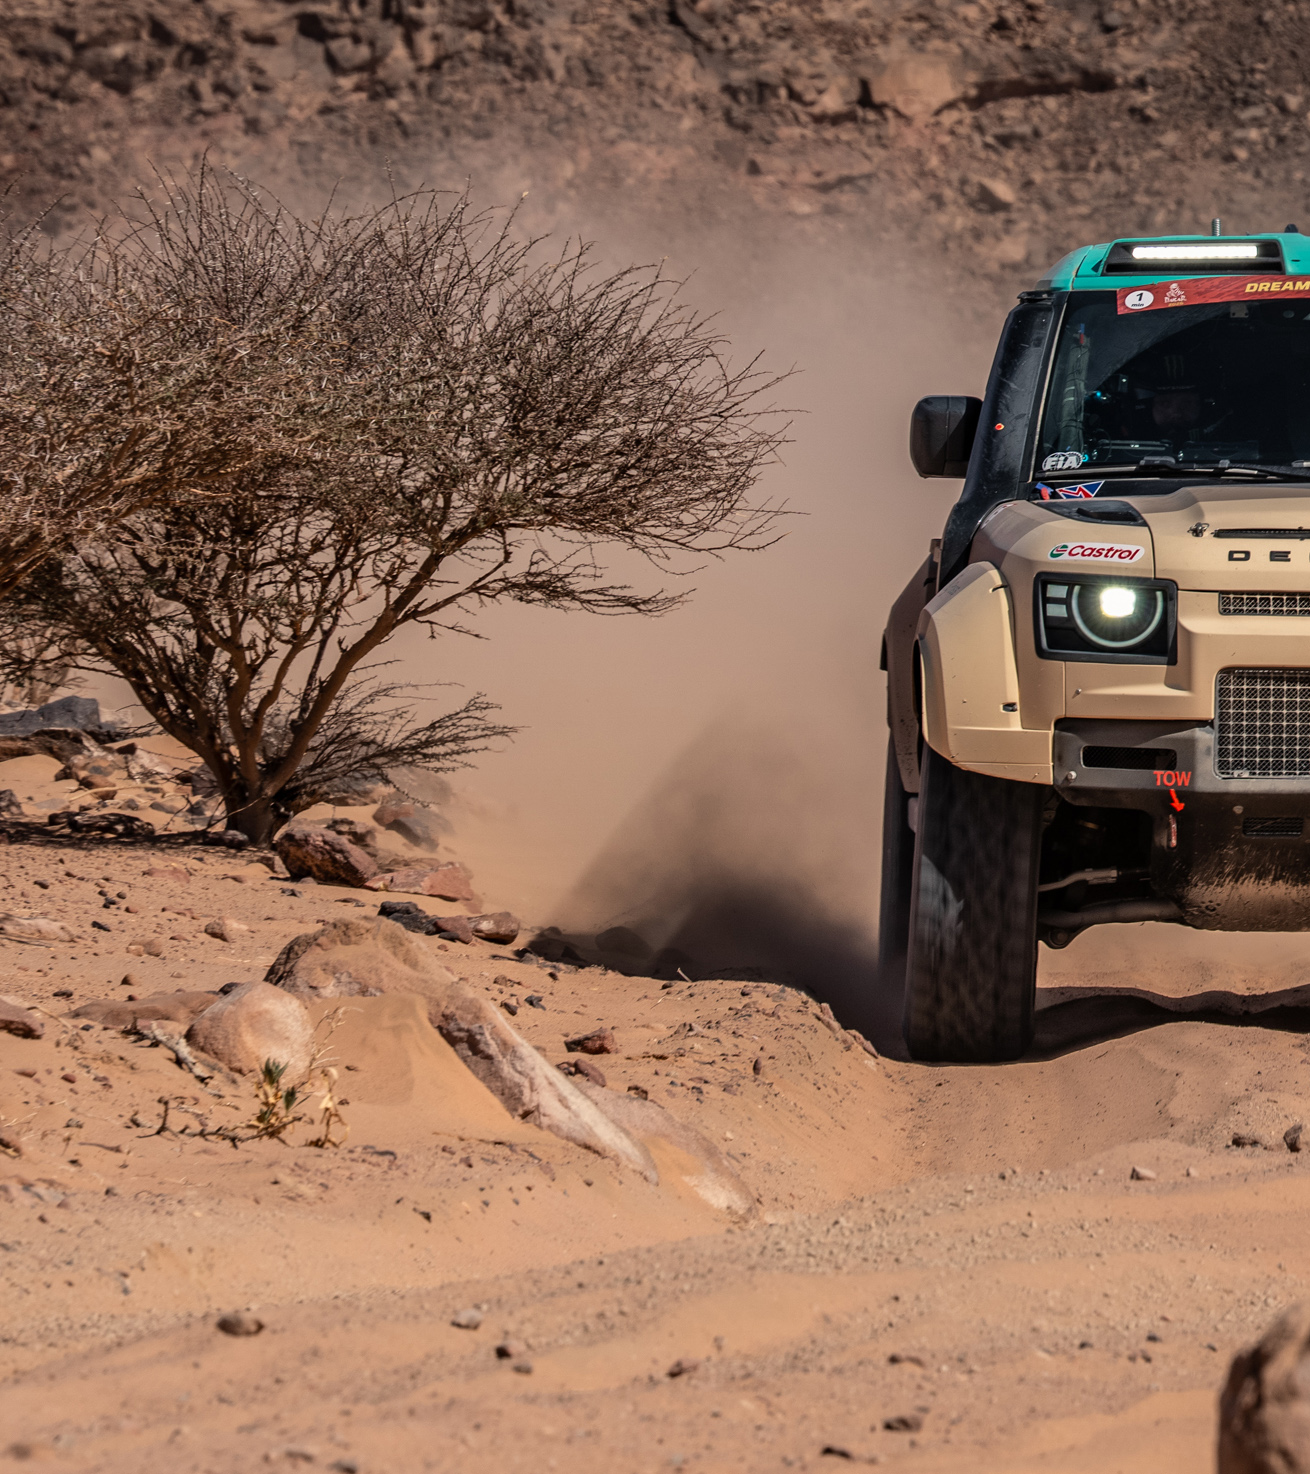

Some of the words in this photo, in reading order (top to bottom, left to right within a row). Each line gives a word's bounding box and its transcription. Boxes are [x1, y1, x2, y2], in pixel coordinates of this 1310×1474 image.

[1135, 292, 1144, 302] 1
[1067, 544, 1141, 561] Castrol
[1153, 770, 1192, 787] TOW
